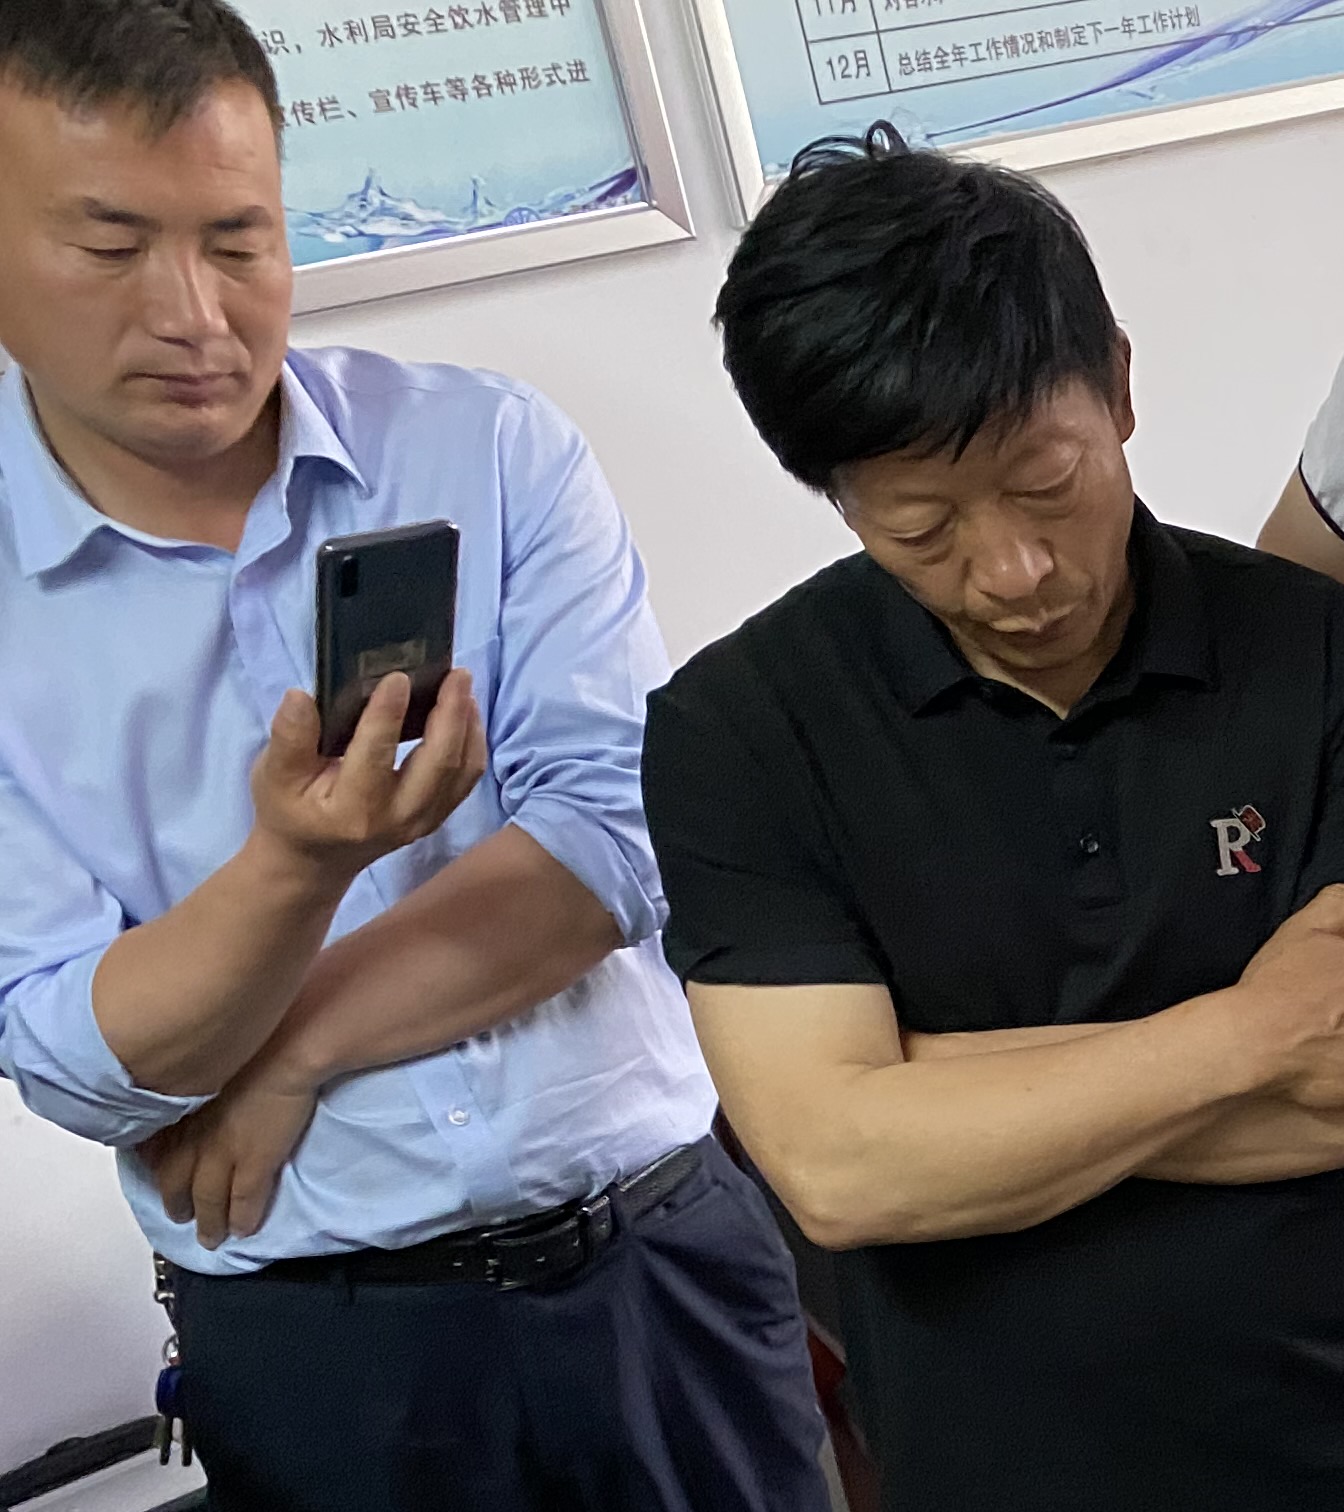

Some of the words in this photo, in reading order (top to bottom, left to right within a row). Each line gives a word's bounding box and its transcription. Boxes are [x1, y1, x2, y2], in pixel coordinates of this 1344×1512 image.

[826, 50, 871, 81] 12月
[898, 4, 1201, 76] 总结全年工作情况和制定下一年工作计划
[283, 58, 591, 128] 传栏、宣传车等各种形式进
